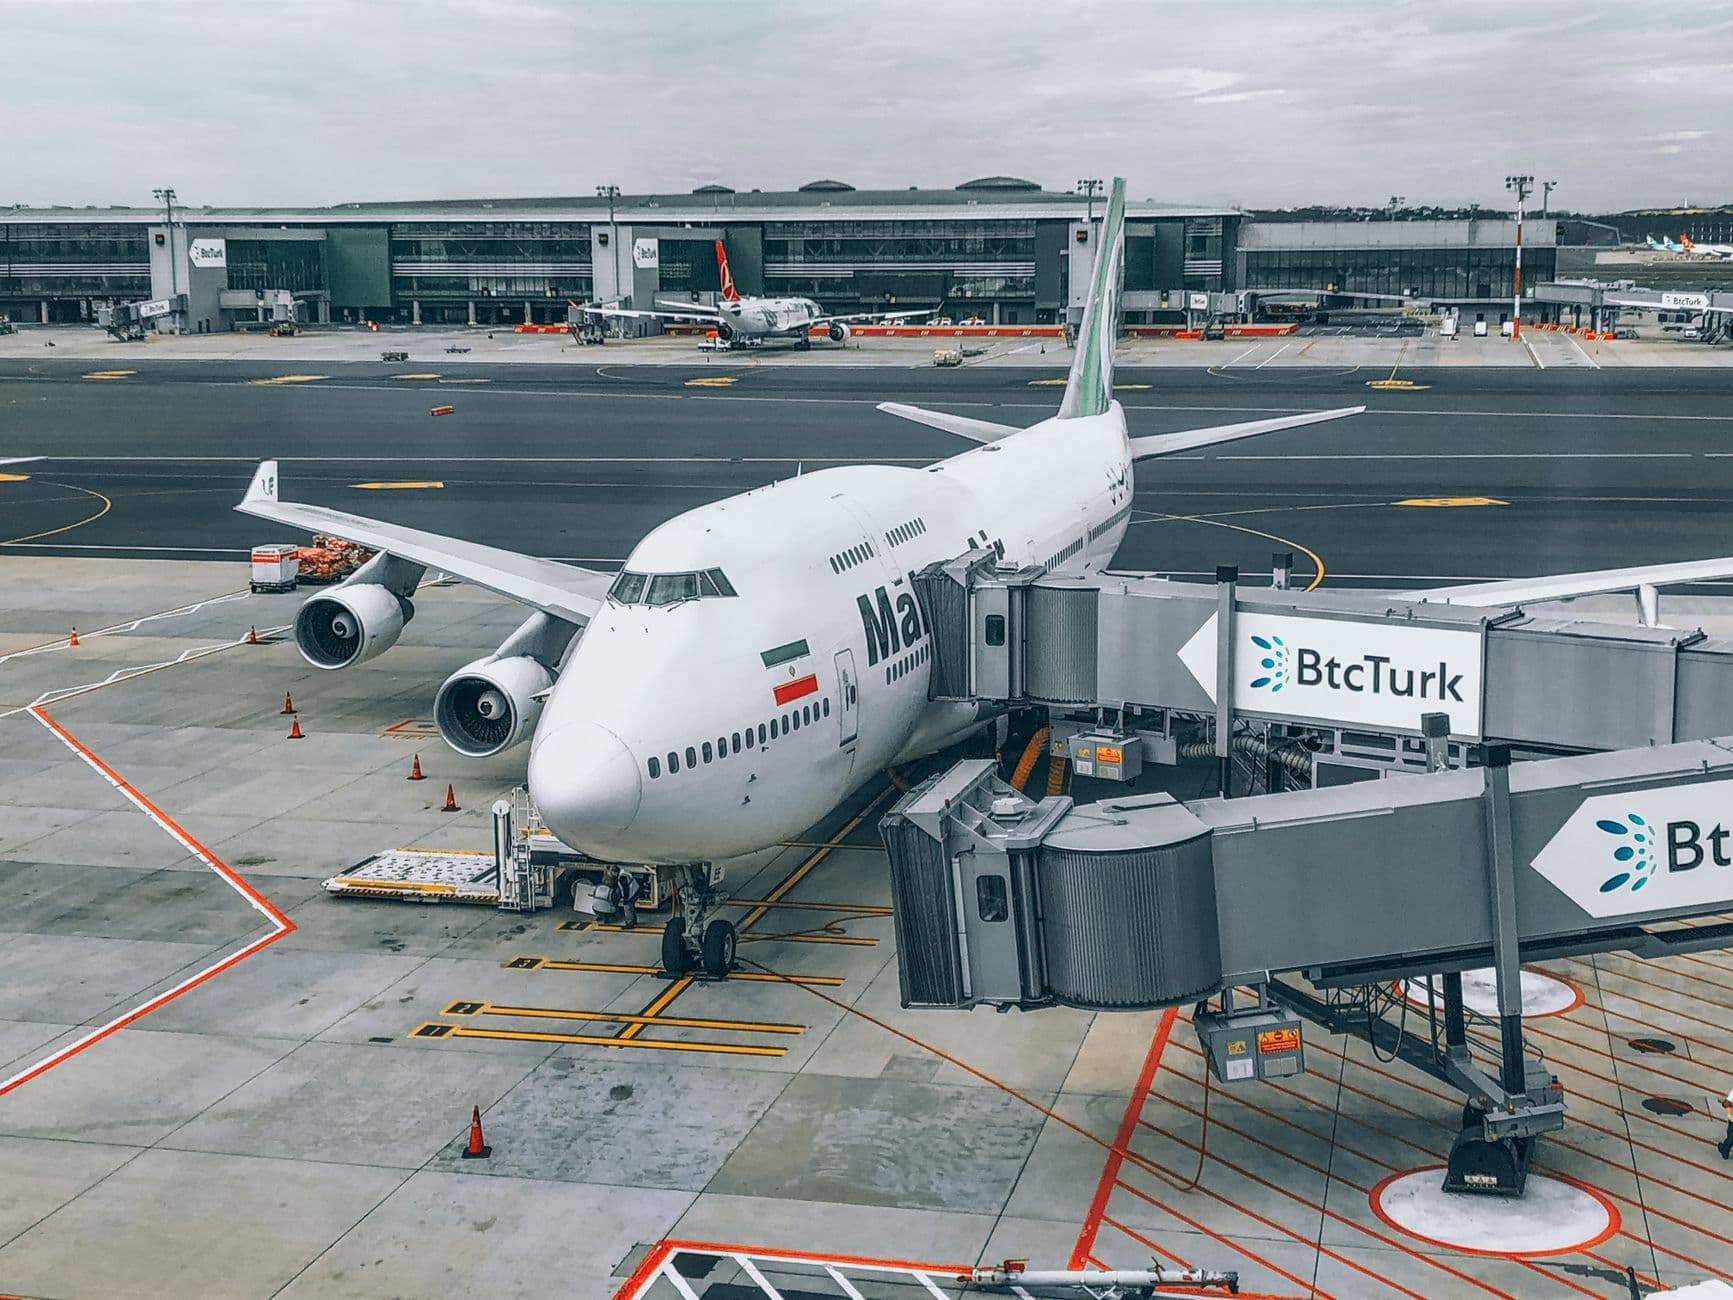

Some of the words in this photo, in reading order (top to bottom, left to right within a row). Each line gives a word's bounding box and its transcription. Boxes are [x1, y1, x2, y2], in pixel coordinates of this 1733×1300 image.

[1673, 297, 1702, 305] BtcTurk
[1297, 648, 1464, 702] BtcTurk
[1667, 820, 1732, 873] Bt
